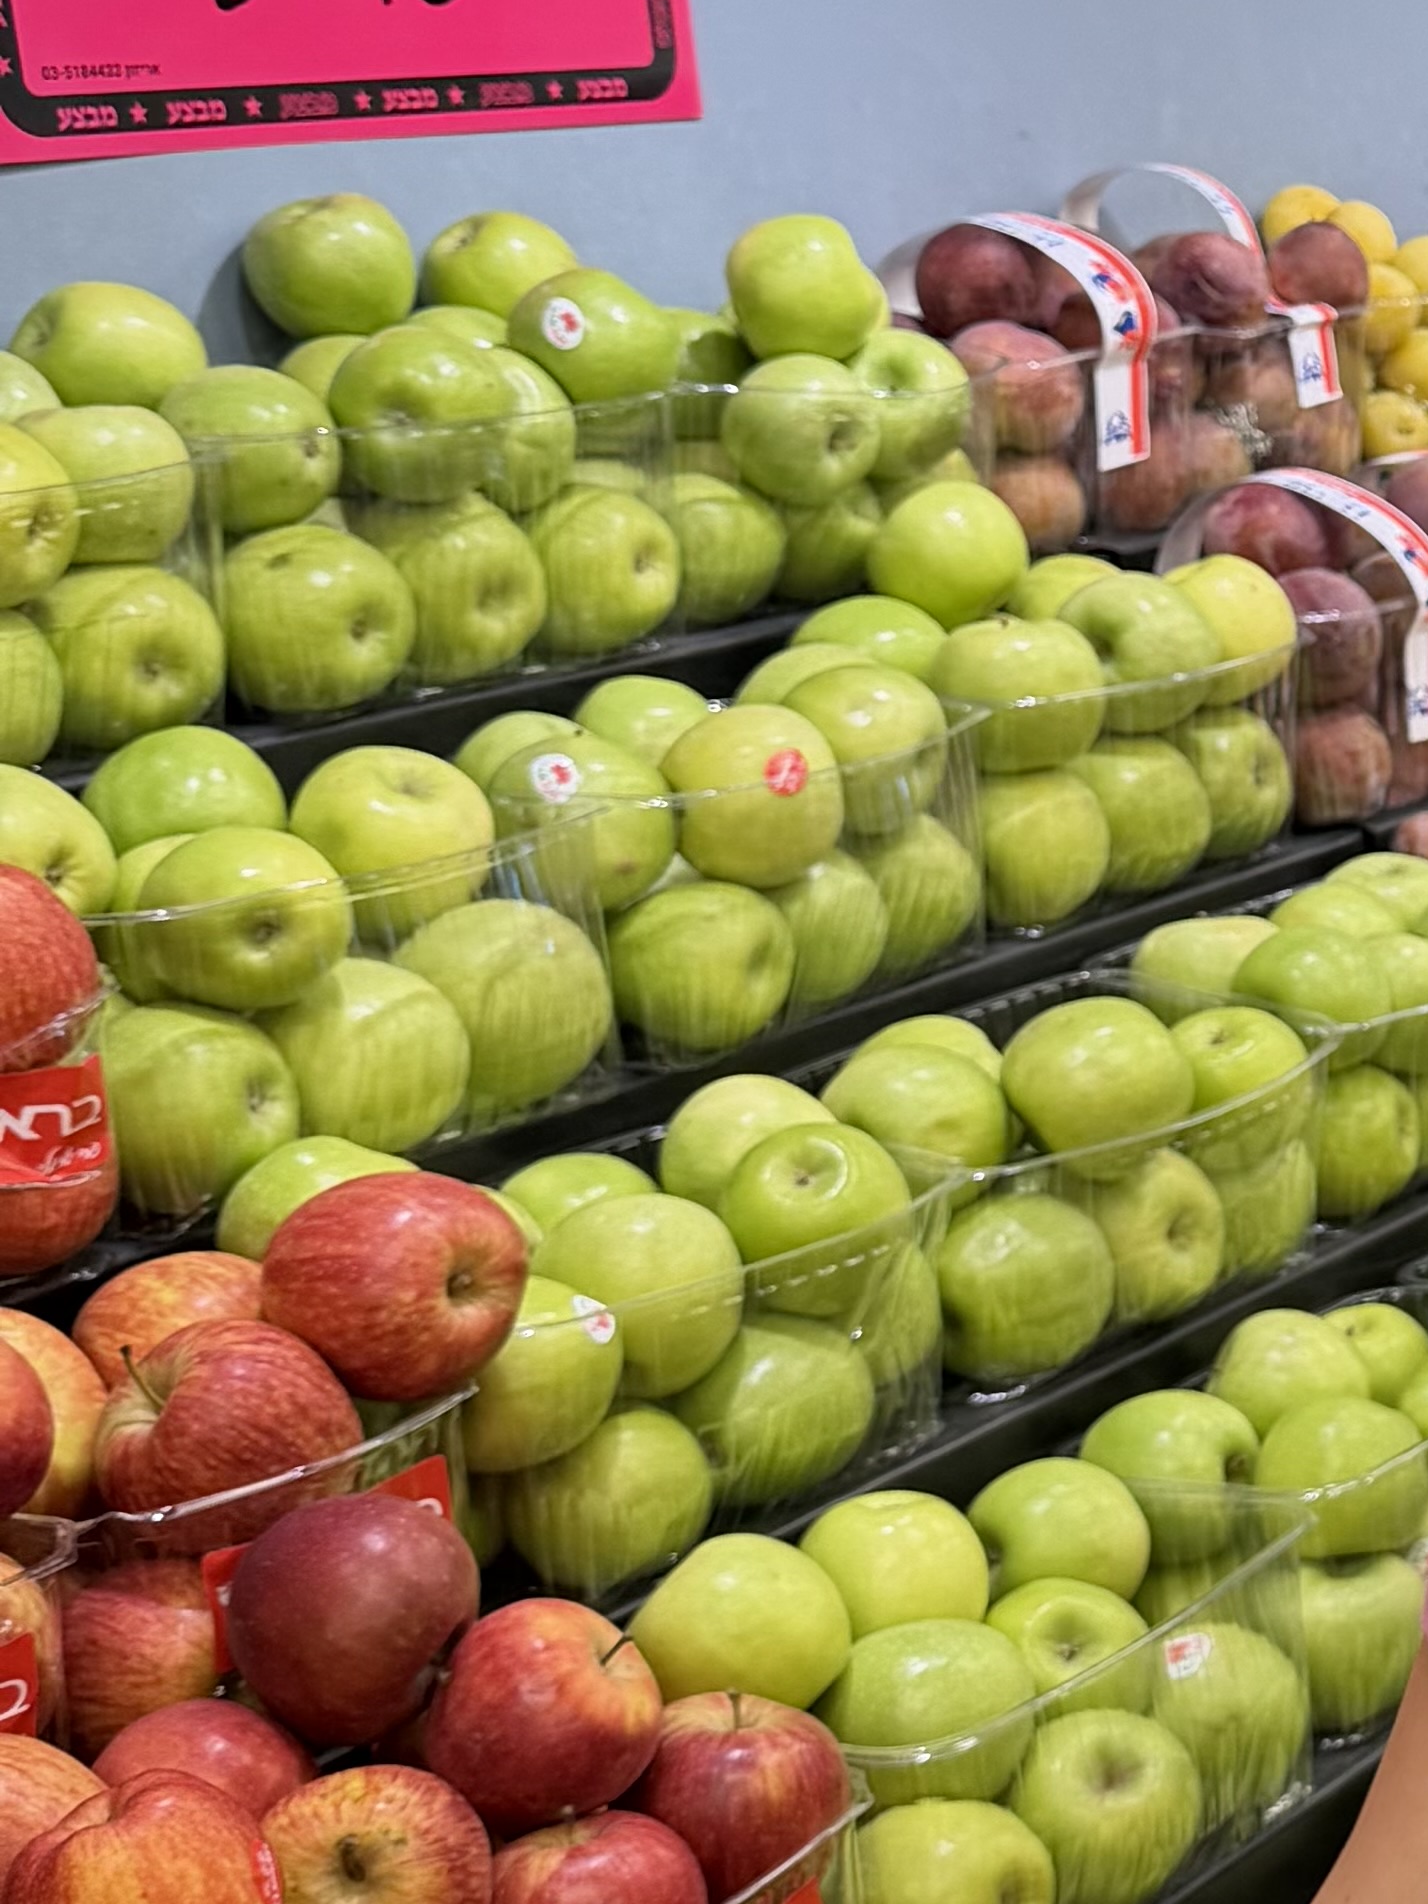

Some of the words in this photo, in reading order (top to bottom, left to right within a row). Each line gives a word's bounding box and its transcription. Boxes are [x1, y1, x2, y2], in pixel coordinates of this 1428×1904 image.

[56, 104, 120, 133] מבצע
[166, 98, 228, 126] מבצע
[0, 1094, 103, 1144] ברא
